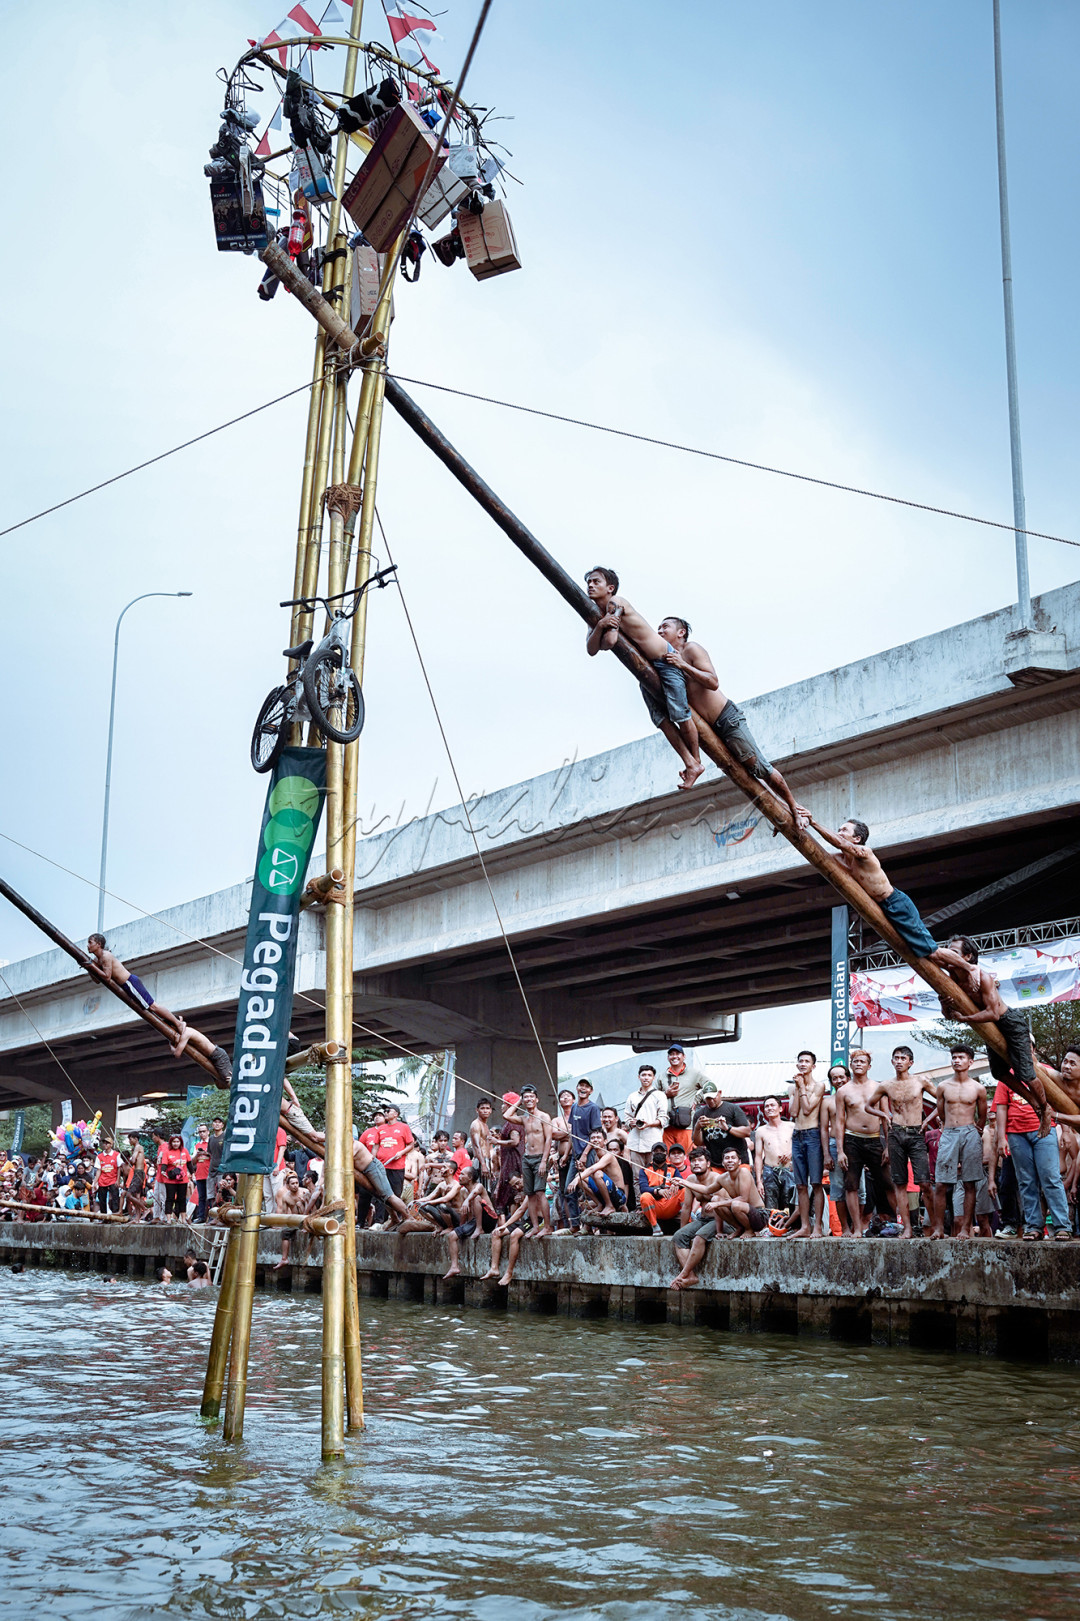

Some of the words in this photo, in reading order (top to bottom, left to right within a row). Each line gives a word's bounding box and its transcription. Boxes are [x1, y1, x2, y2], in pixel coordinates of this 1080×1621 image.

[343, 166, 370, 206] TECSTAR
[230, 911, 292, 1152] Pegadaian
[833, 960, 848, 1052] Pegadaian
